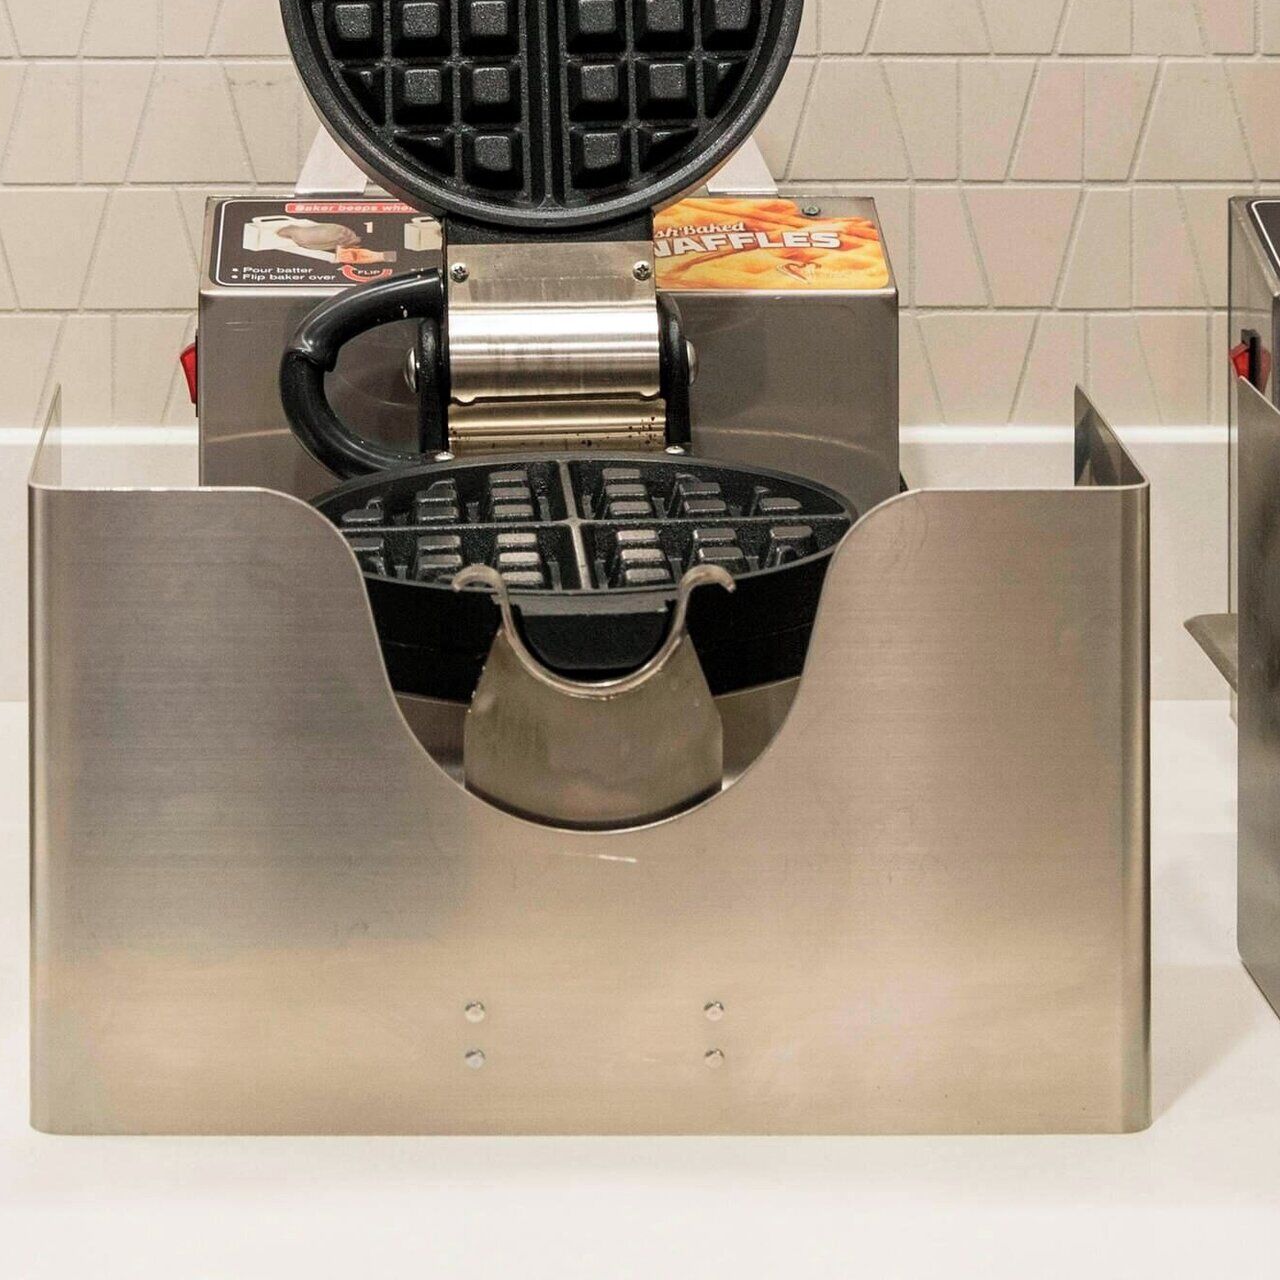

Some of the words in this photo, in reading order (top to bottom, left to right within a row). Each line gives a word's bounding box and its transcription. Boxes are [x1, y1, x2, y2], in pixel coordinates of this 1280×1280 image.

[338, 205, 378, 213] beeps
[363, 222, 374, 234] 1
[685, 222, 746, 236] Baked
[243, 266, 273, 274] Pour
[276, 266, 314, 274] batter
[243, 273, 267, 282] Flip
[269, 273, 307, 281] baker
